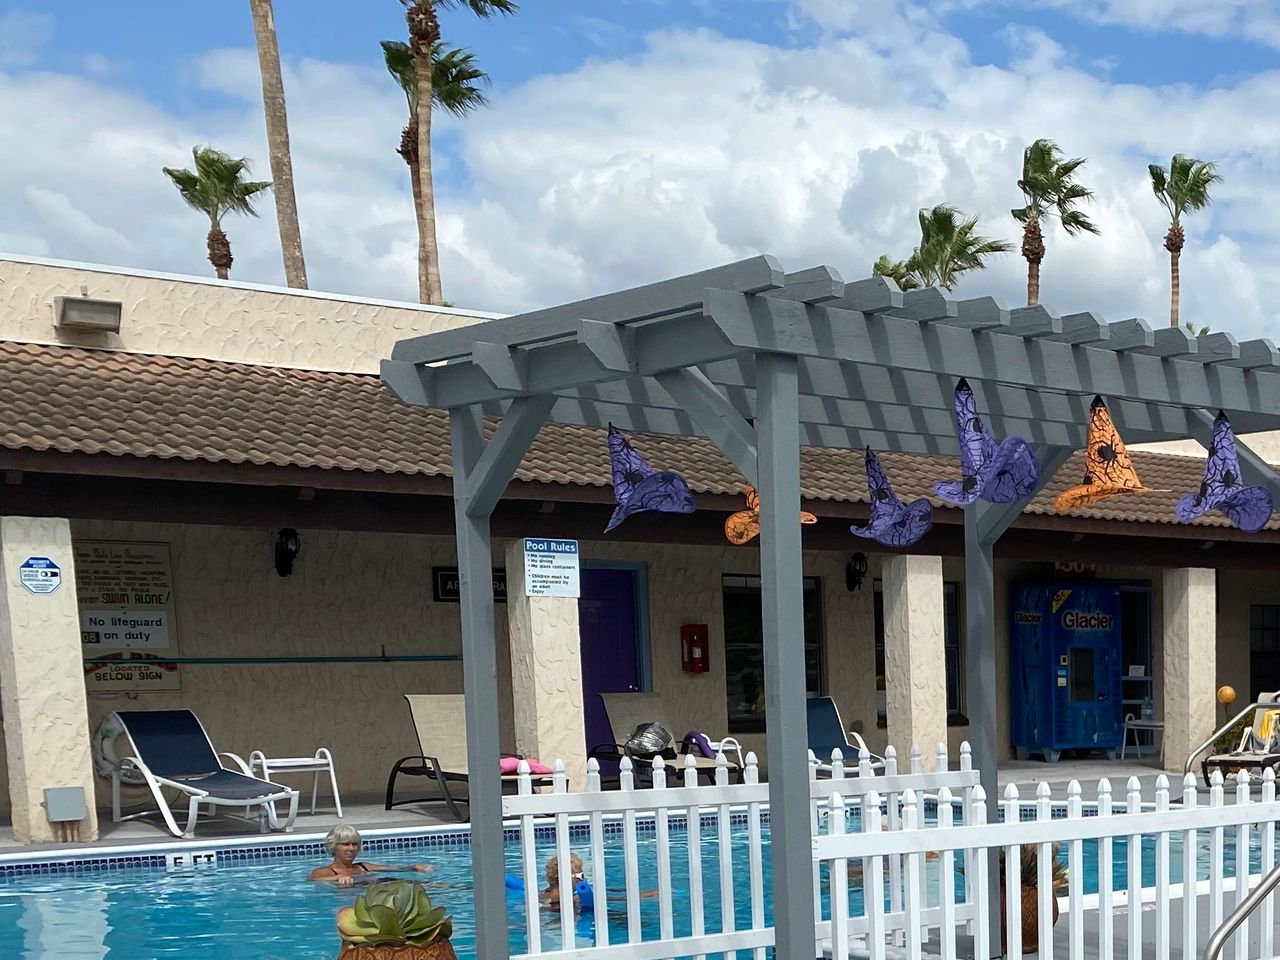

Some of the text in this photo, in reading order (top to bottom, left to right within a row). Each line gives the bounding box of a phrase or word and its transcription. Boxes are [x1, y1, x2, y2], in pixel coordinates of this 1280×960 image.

[526, 540, 576, 552] Pool Rules
[102, 592, 130, 605] SWIM
[89, 617, 162, 628] No lifeguard
[1015, 612, 1042, 623] Glacier
[1062, 610, 1114, 629] Glacier
[103, 631, 150, 641] on duty
[95, 671, 163, 681] BELOW SIGN
